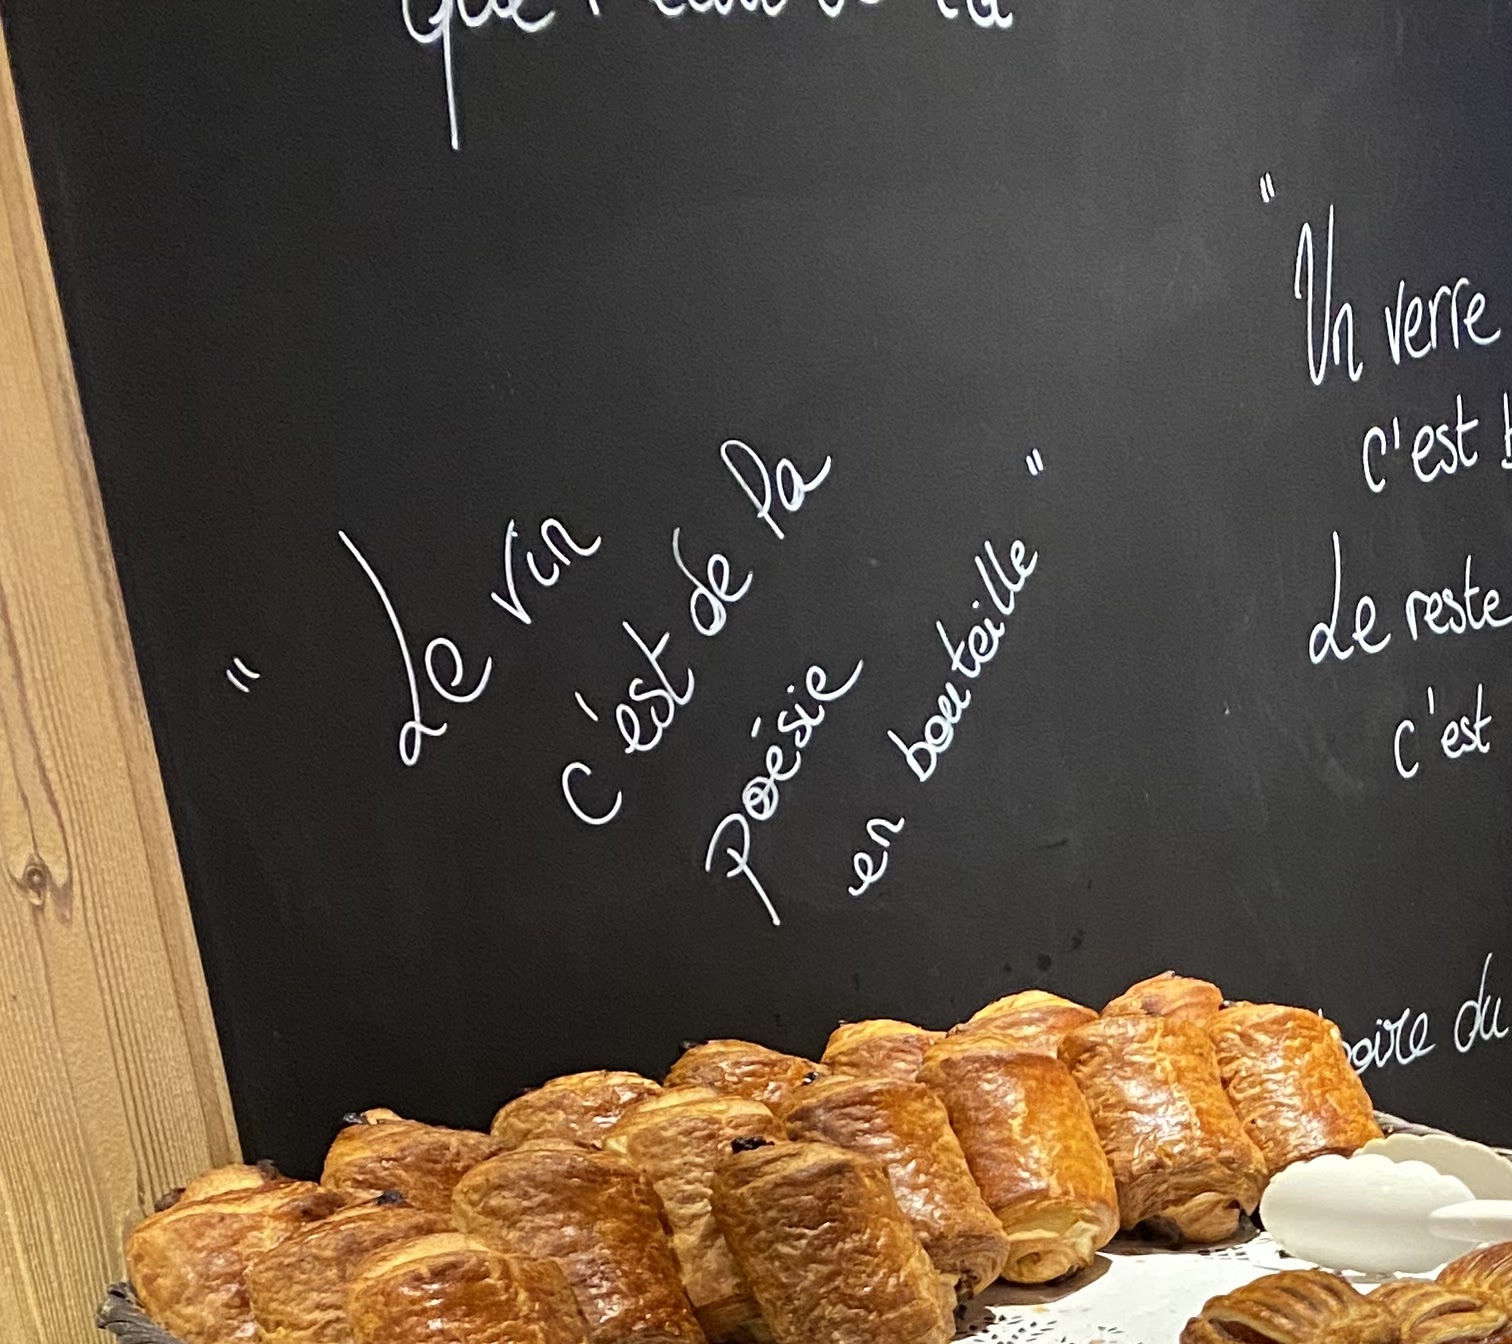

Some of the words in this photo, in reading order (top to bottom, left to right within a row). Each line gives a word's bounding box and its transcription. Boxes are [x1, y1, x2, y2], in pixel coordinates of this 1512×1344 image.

[1294, 204, 1364, 386] Un
[1384, 277, 1502, 364] verre
[1362, 392, 1480, 493] c'est
[339, 530, 493, 766] Le
[491, 517, 603, 625] vin
[562, 620, 695, 825] c'est
[671, 527, 754, 637] de
[1308, 530, 1392, 664] Le
[847, 816, 905, 896] en
[888, 540, 1039, 783] bouteille
[1392, 683, 1492, 778] c'est
[1338, 1005, 1437, 1076] oire
[1454, 951, 1510, 1053] du
